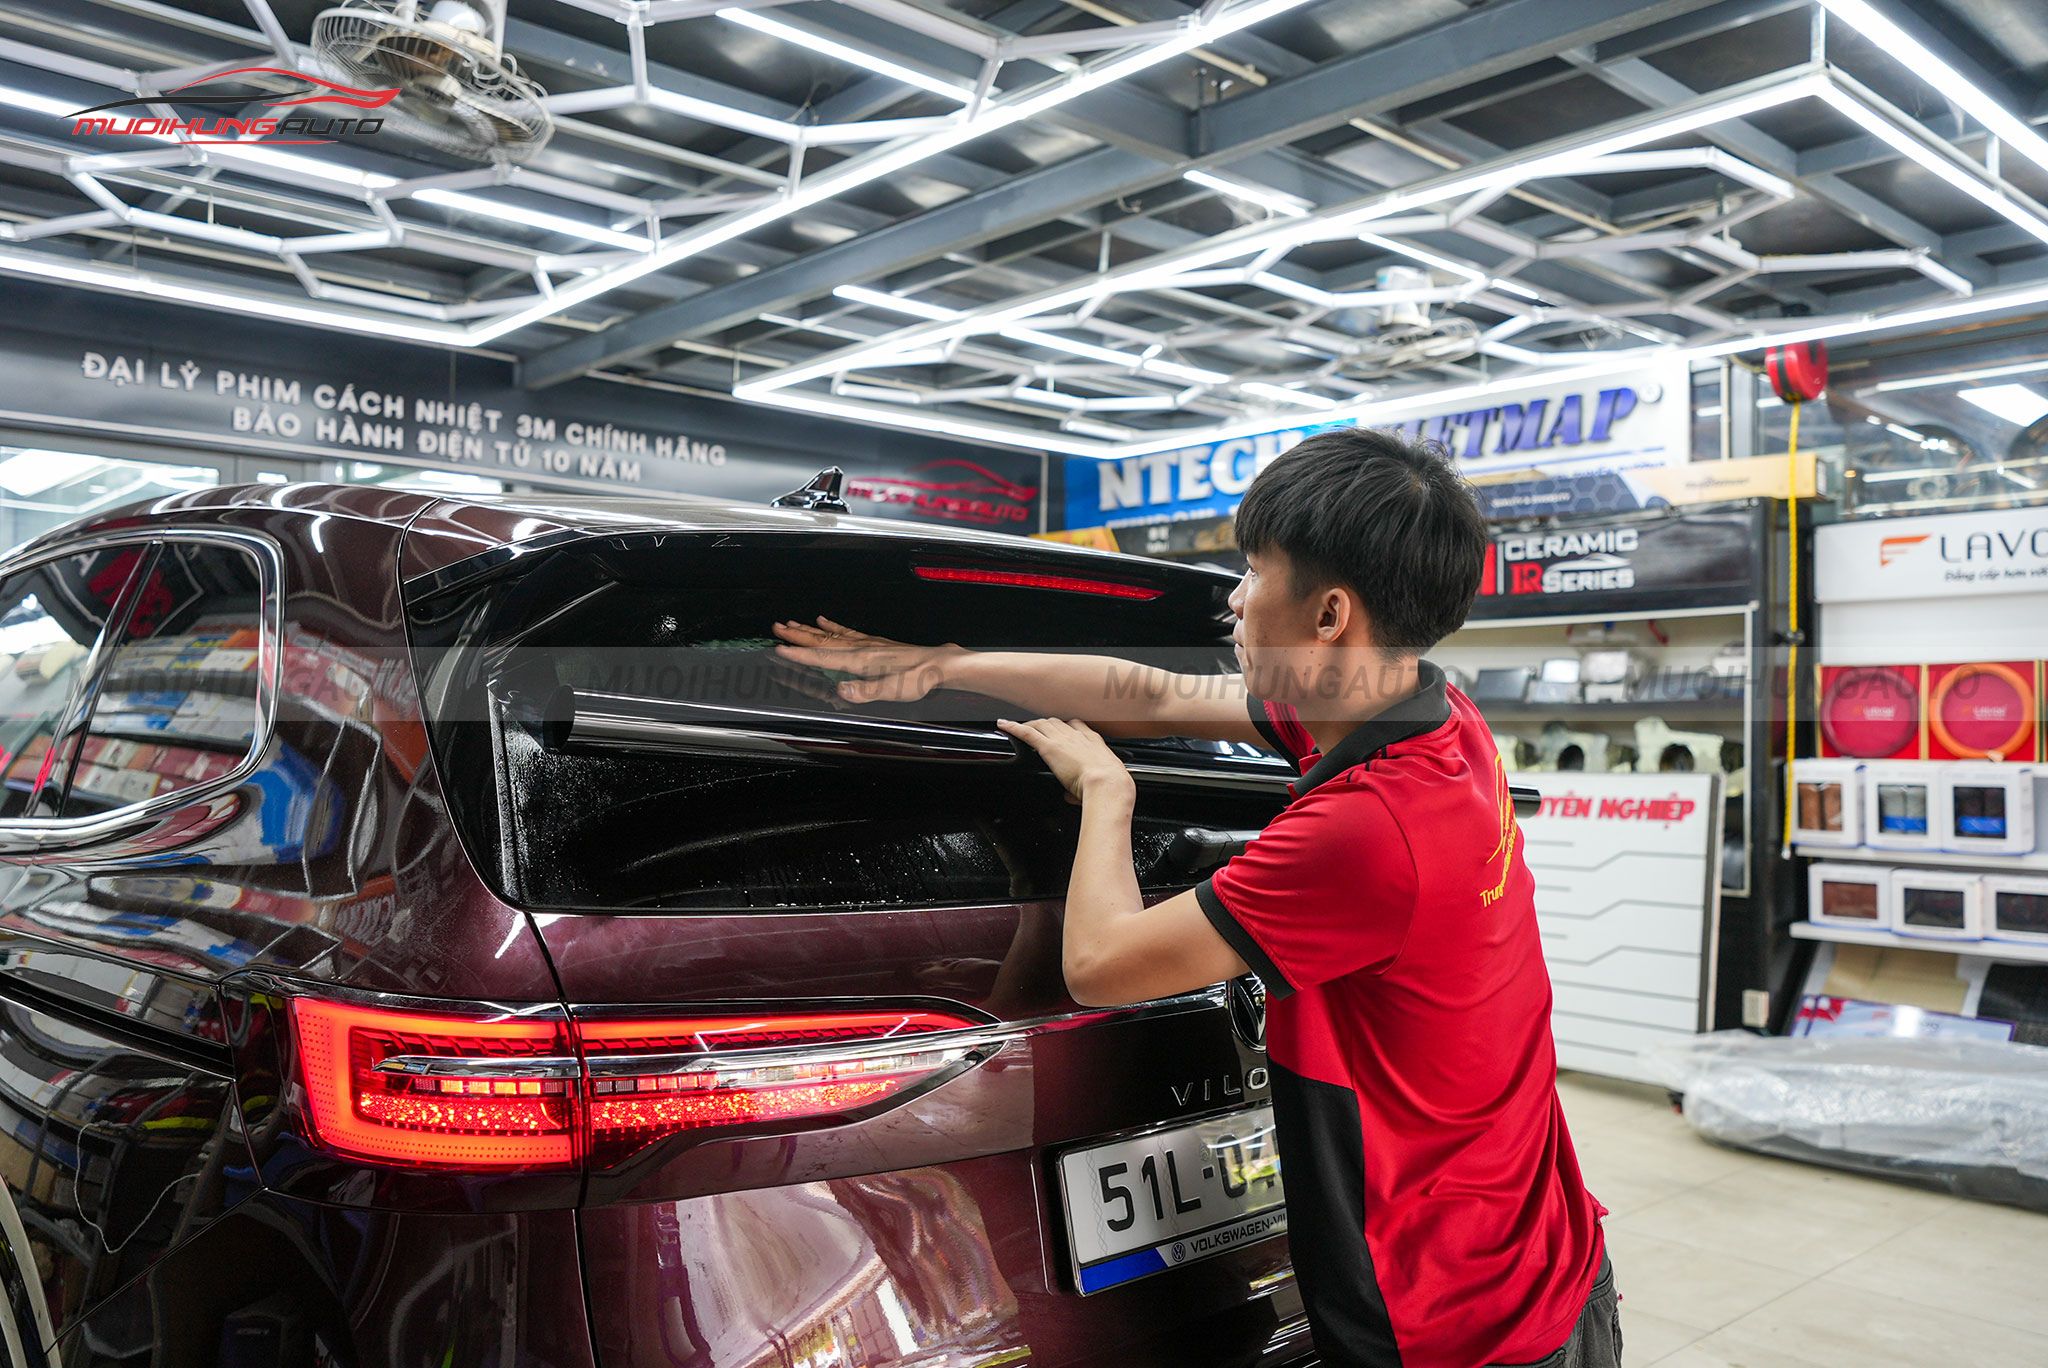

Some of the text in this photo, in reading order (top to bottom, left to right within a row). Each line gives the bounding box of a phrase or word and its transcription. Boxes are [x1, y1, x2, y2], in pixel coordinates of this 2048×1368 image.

[82, 352, 145, 387] ĐẠI
[215, 370, 301, 405] PHIM
[313, 383, 404, 419] CÁCH
[415, 398, 503, 435] NHIỆT
[516, 414, 556, 441] 3M
[565, 423, 648, 455] CHÍNH
[417, 429, 483, 463] ĐIỆN
[541, 450, 571, 473] 10
[1504, 528, 1640, 562] CERAMIC
[1542, 568, 1636, 595] SERIES
[1598, 793, 1697, 830] NGHIỆP
[1171, 1067, 1269, 1107] VILO
[1190, 1213, 1286, 1254] VOLKSWAGEN-VI
